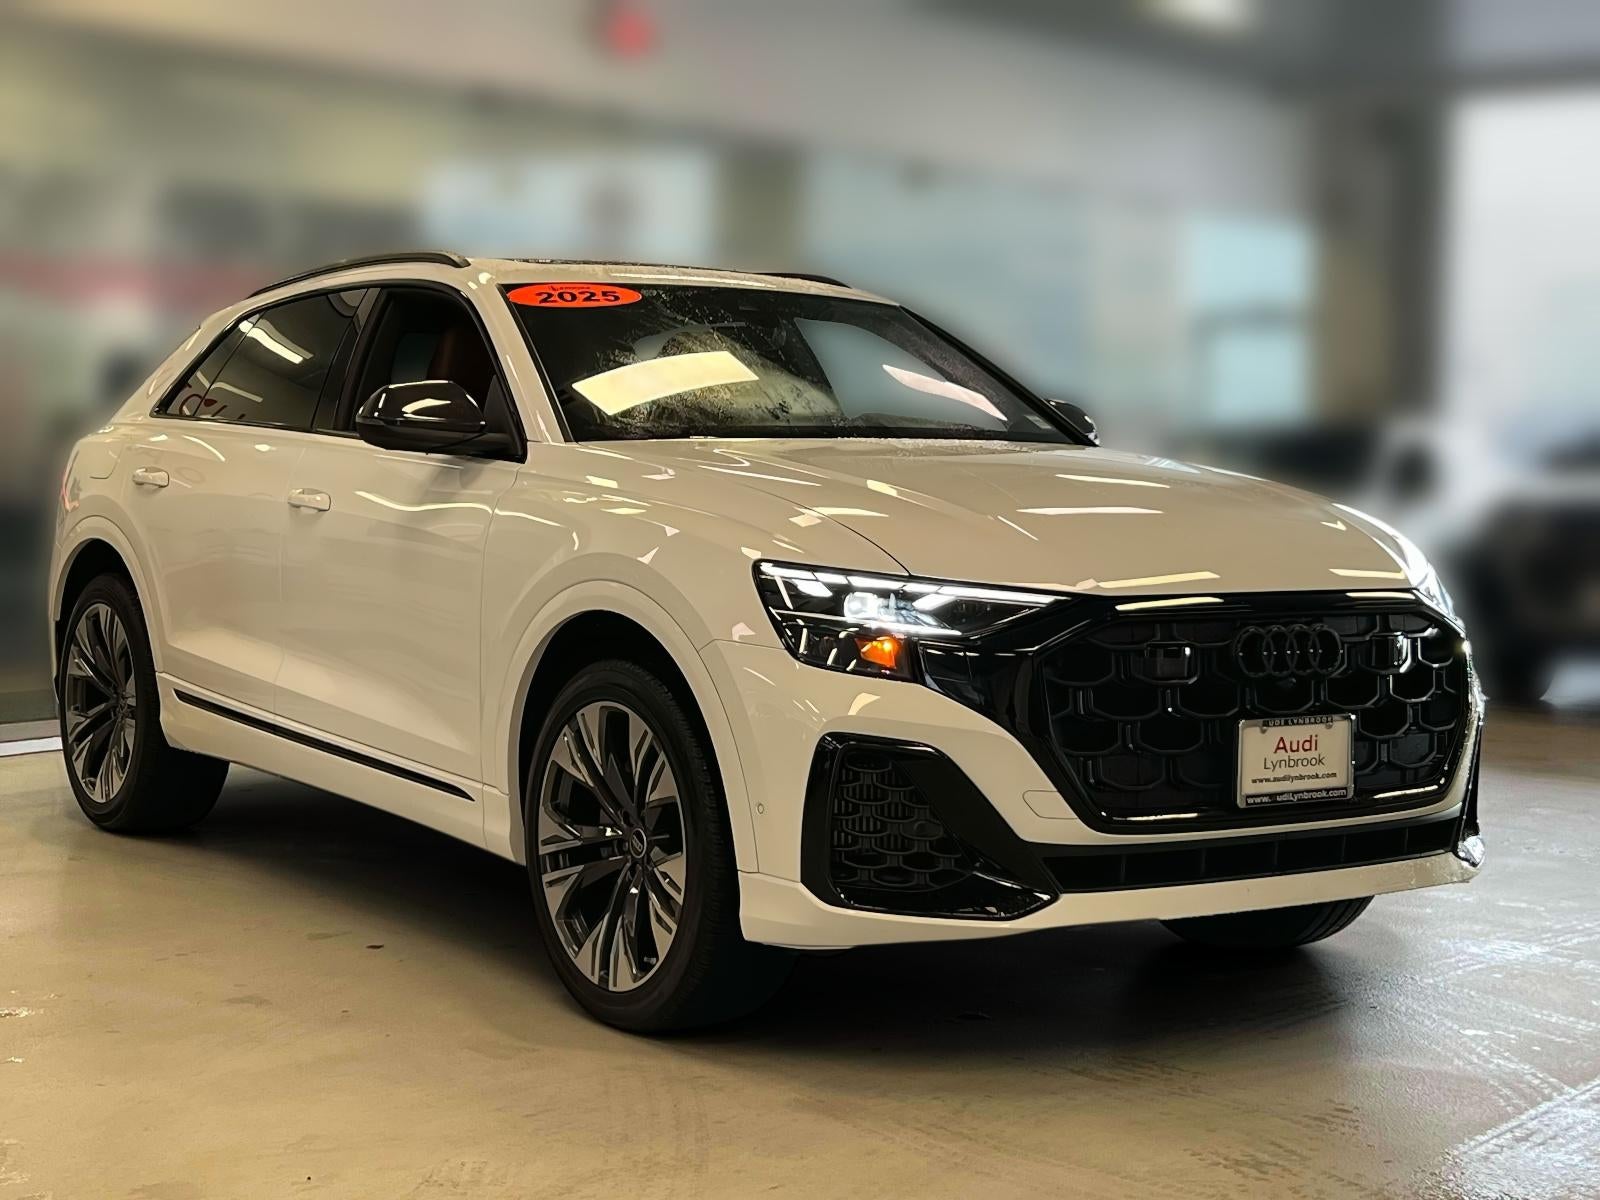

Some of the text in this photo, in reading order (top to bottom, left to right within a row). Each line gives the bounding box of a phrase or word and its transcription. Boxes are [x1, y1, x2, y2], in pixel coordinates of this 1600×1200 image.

[535, 291, 620, 304] 2025
[1273, 735, 1318, 753] Audi
[1263, 755, 1325, 772] Lynbrook
[1251, 772, 1337, 784] www.audilynbrook.com
[1246, 789, 1346, 804] www.udiLynbrook.com
